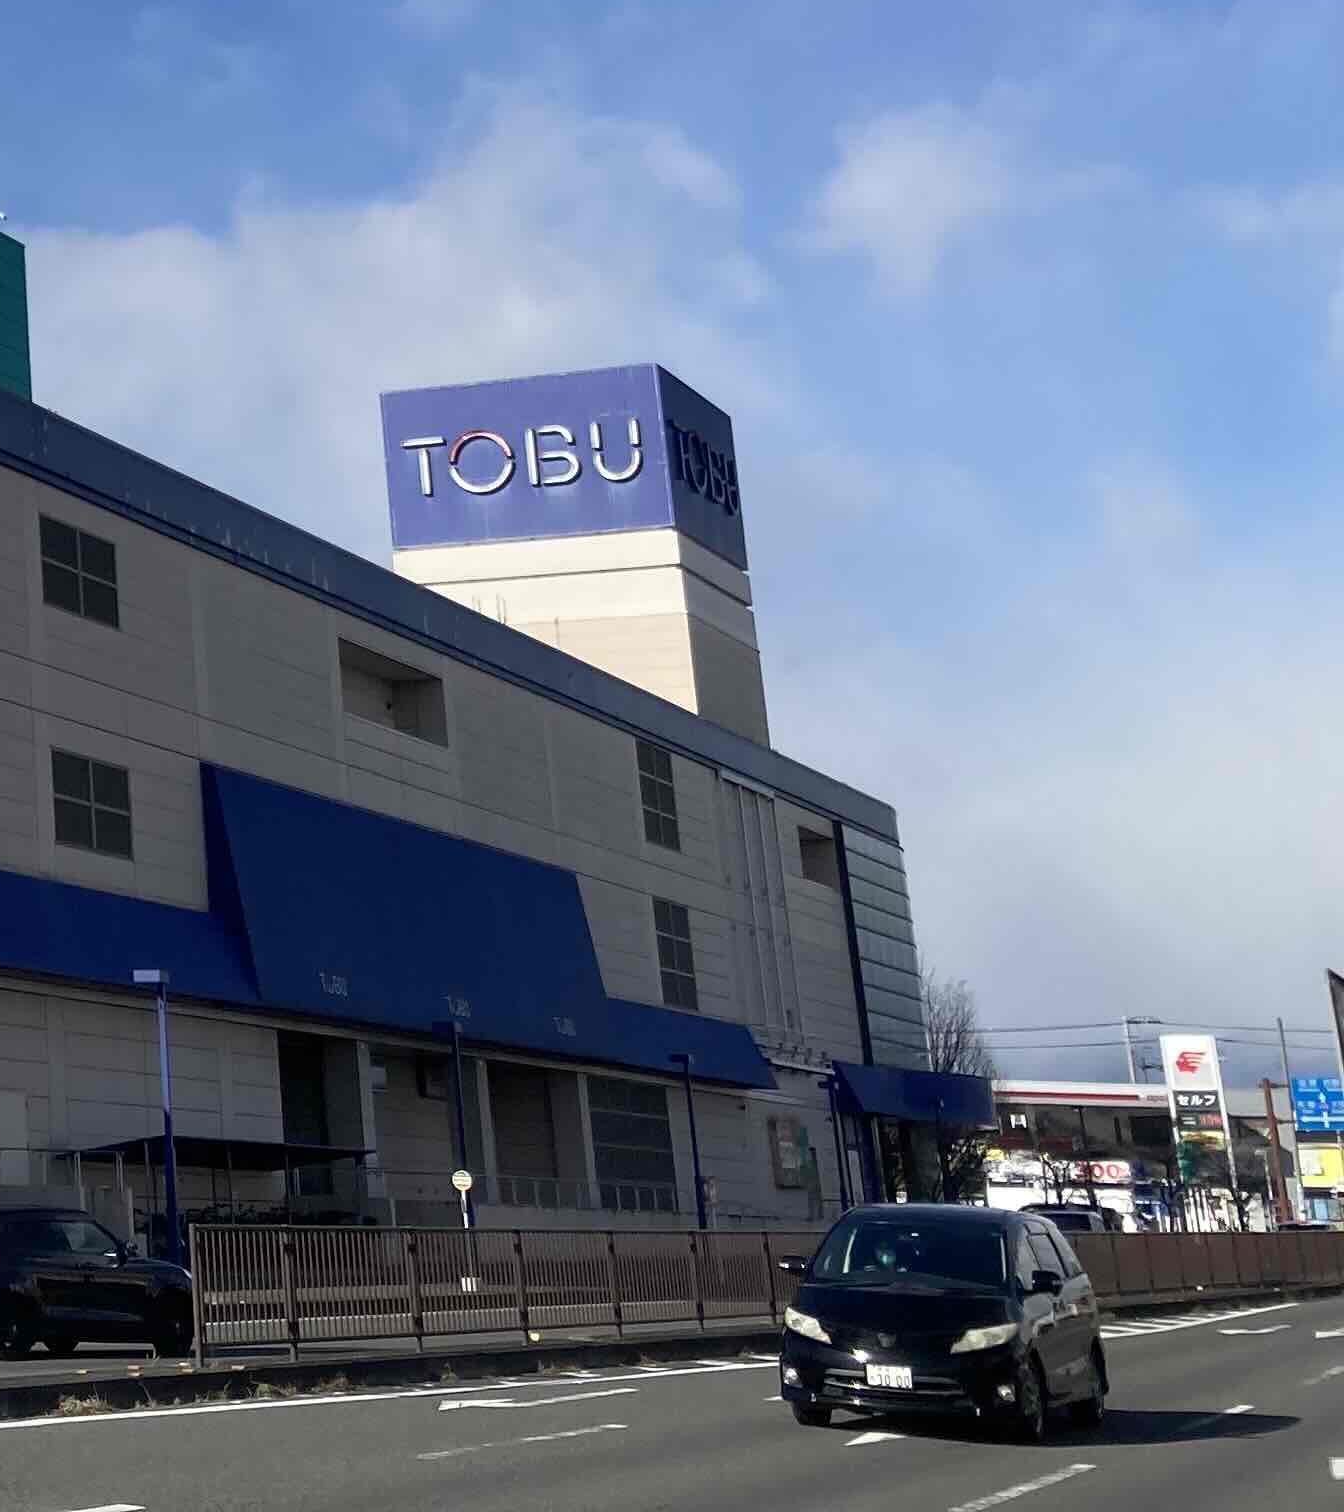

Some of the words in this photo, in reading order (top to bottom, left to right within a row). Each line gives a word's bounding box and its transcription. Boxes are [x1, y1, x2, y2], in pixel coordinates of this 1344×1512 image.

[400, 418, 643, 497] TOBU
[1176, 1094, 1216, 1106] セルフ
